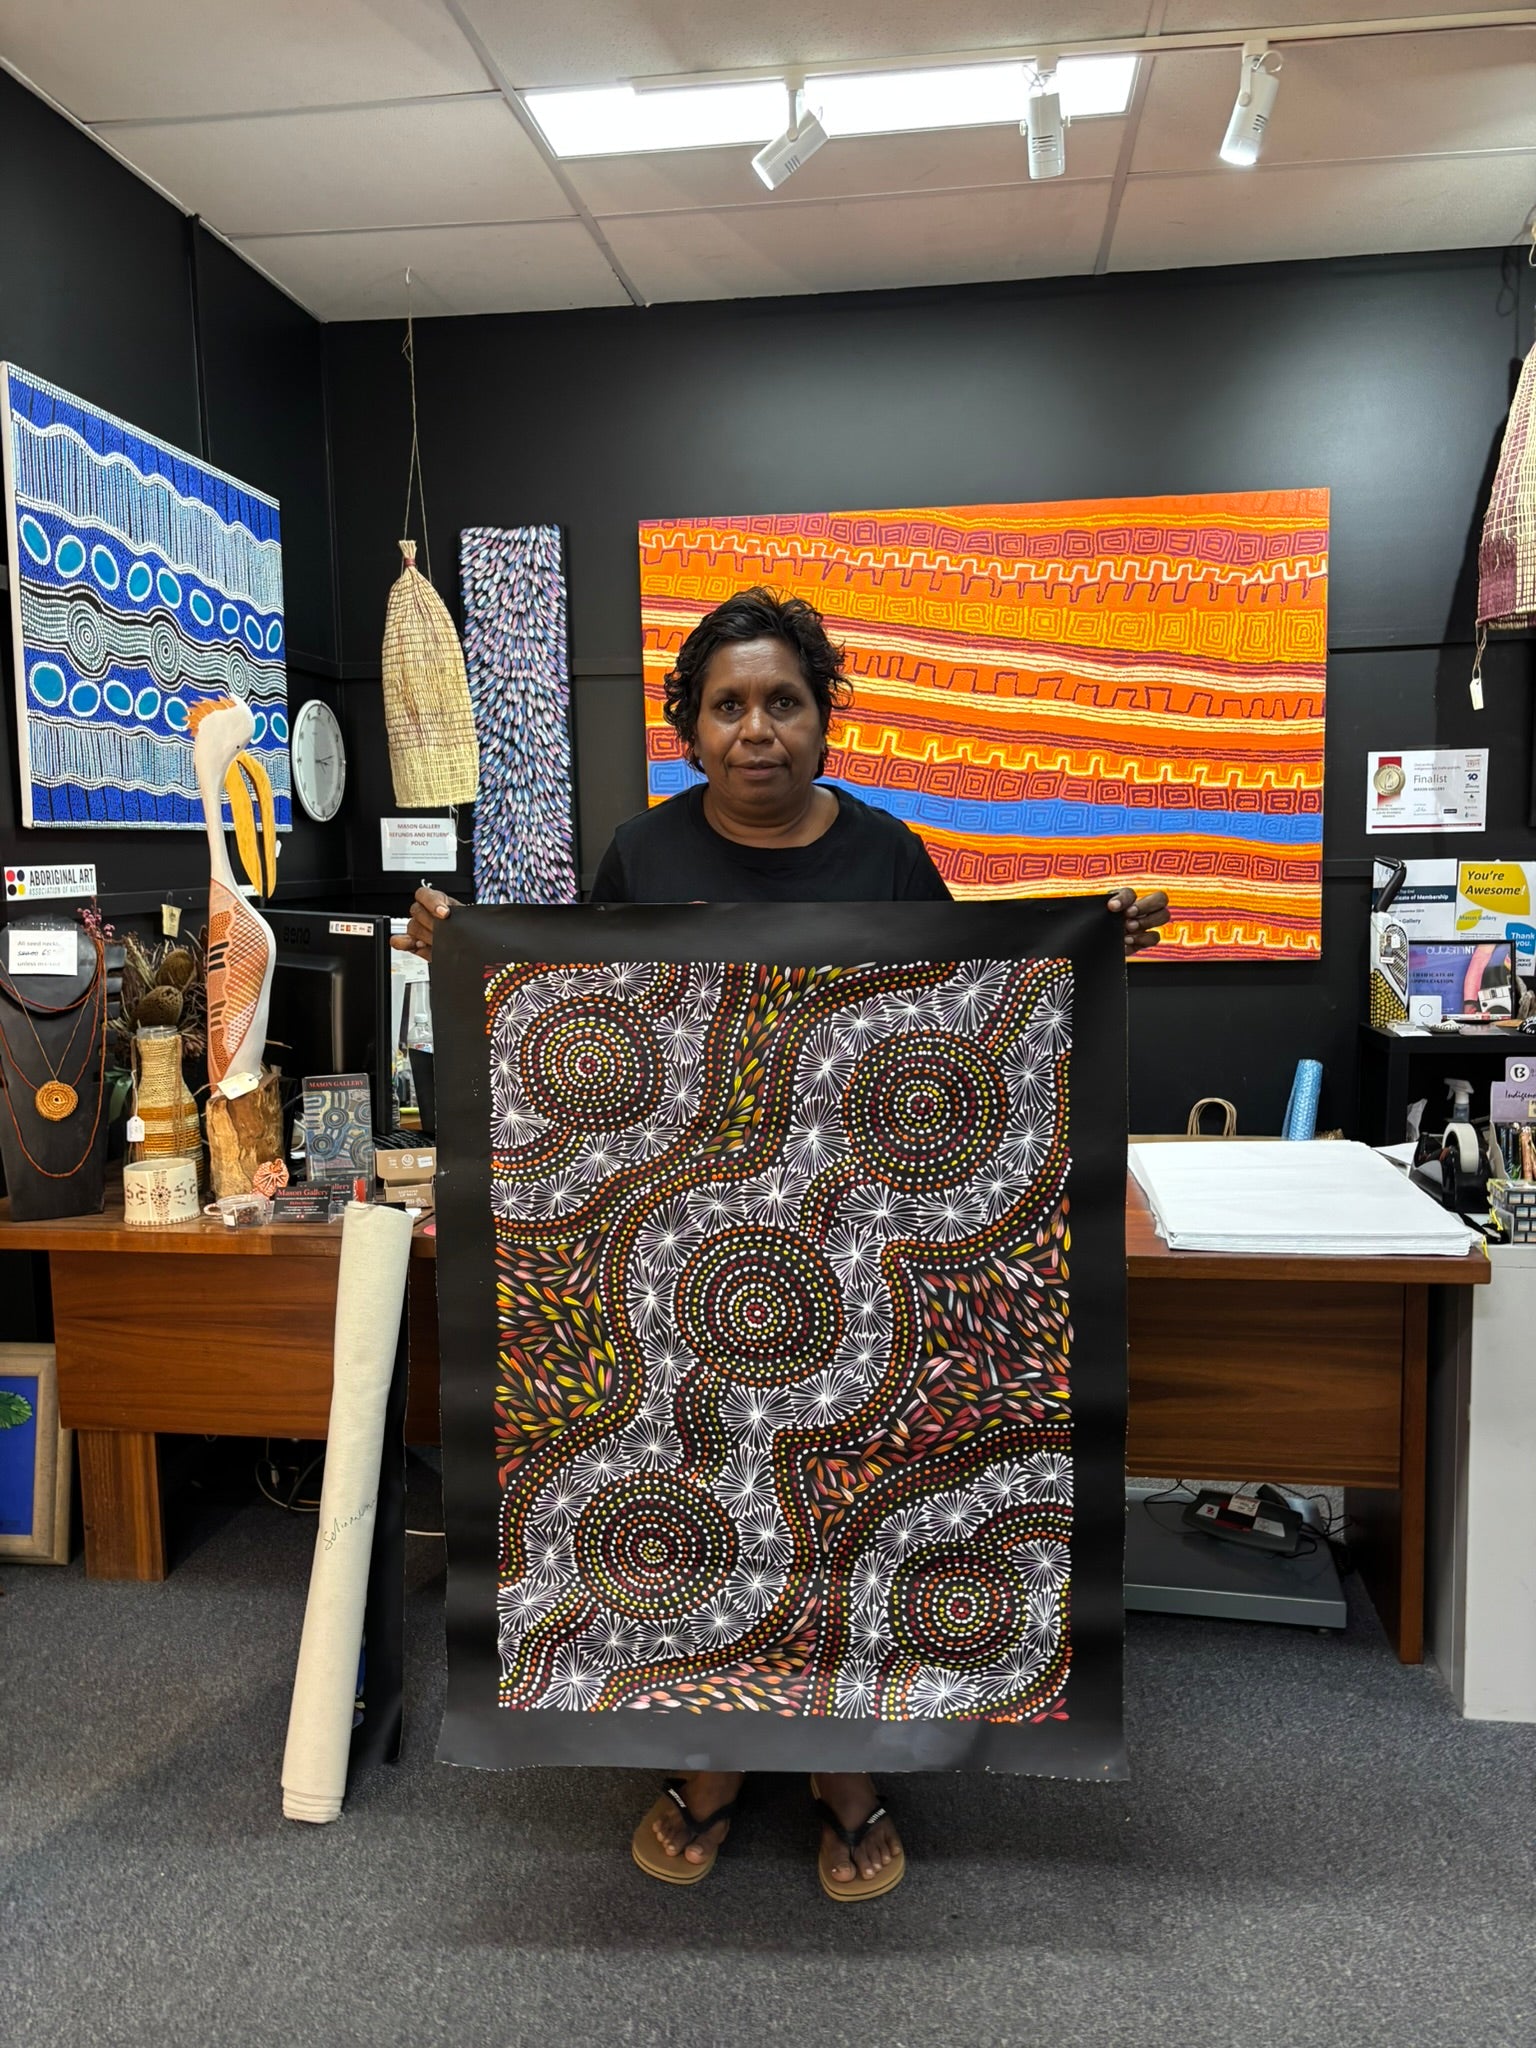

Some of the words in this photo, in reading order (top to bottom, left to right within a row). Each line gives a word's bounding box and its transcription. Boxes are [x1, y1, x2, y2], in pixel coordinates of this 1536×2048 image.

[1414, 774, 1448, 784] Finalist
[30, 868, 77, 886] ABORIGINAL
[80, 868, 94, 883] ART
[1467, 870, 1504, 880] You're
[29, 887, 60, 896] ASSOCIATION
[70, 885, 95, 893] AUSTRALIA
[1465, 885, 1526, 896] Awesome!
[1478, 914, 1497, 922] Gallery
[277, 1189, 302, 1197] Mason
[303, 1189, 328, 1197] Gallery
